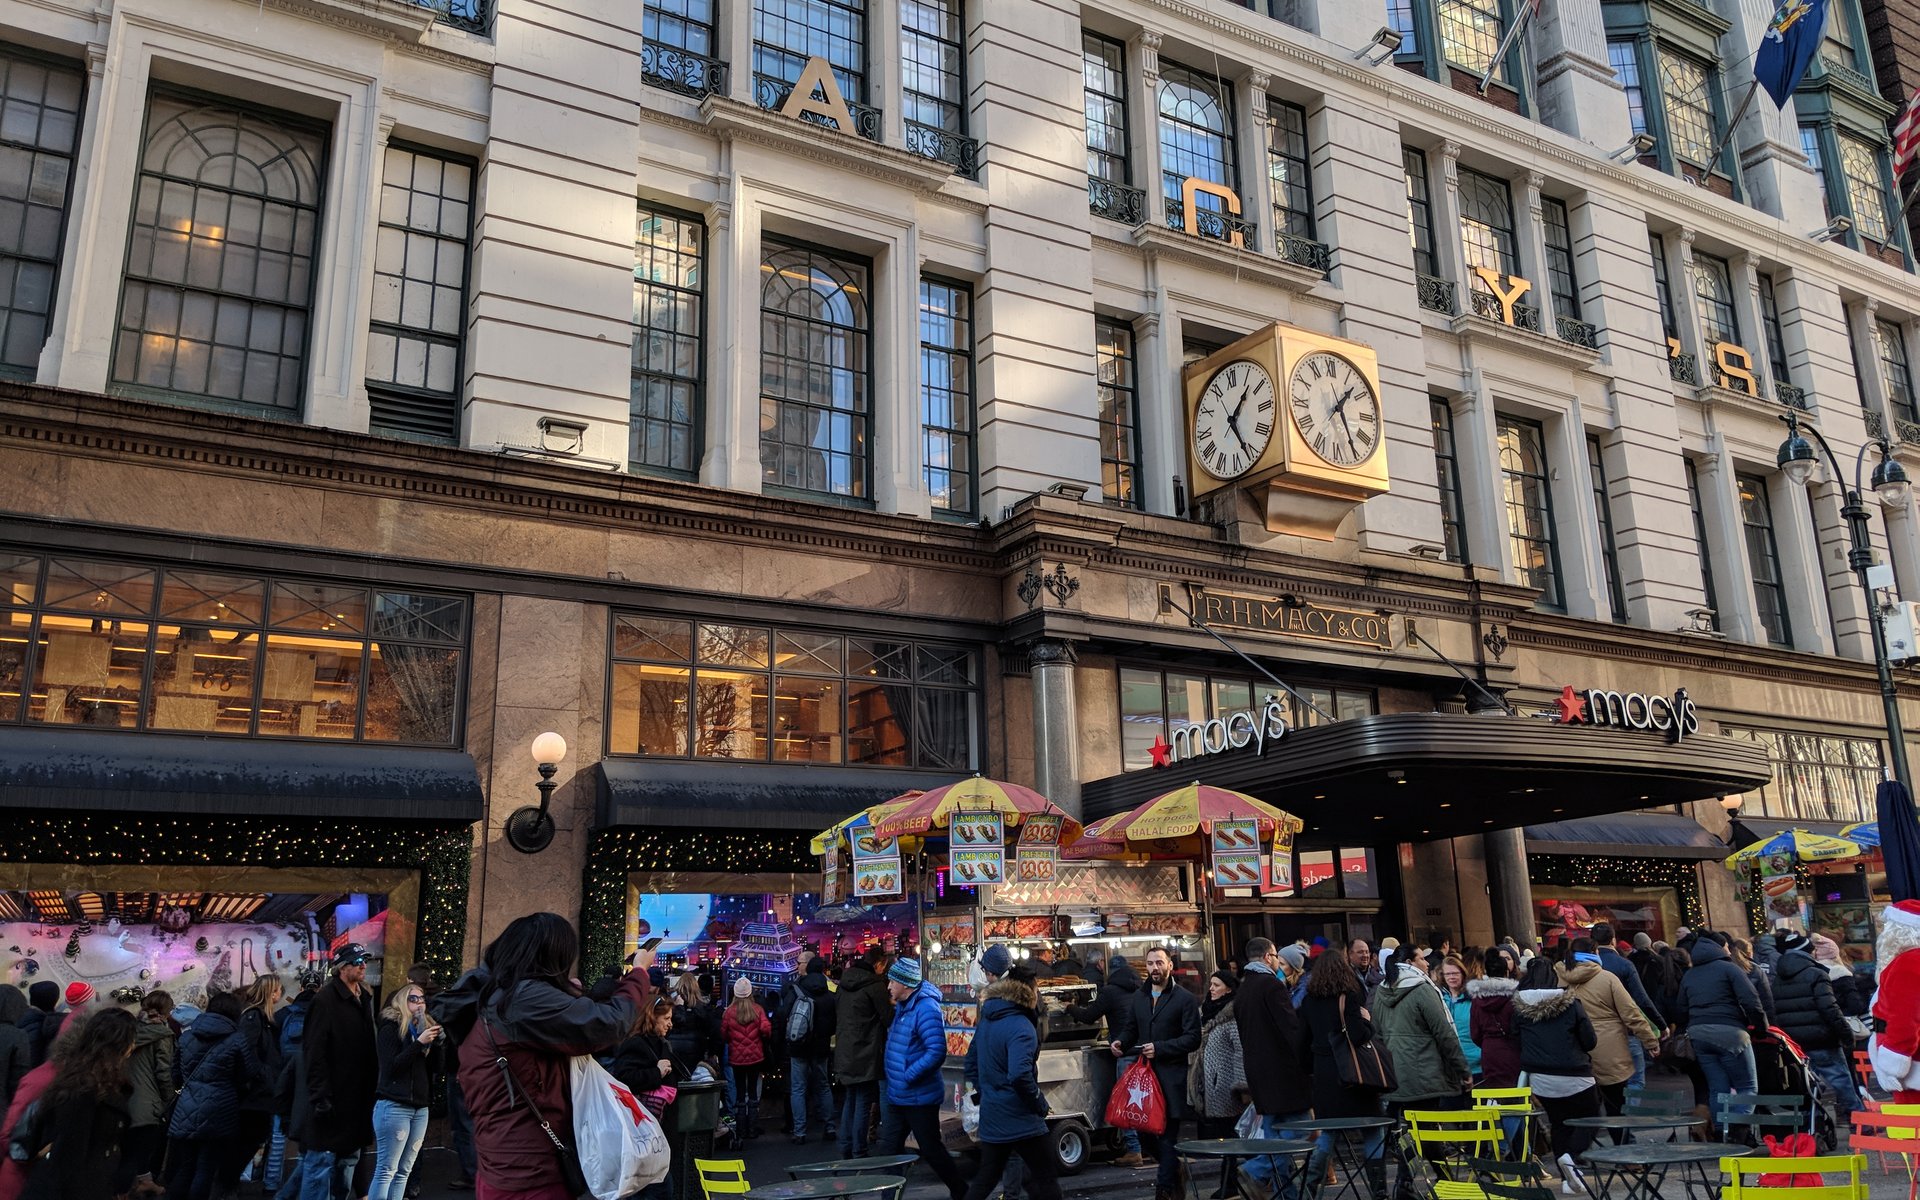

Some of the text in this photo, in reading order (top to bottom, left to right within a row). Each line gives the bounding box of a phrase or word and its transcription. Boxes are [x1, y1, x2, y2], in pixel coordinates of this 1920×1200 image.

[1586, 687, 1699, 743] macy's
[1171, 693, 1287, 763] macy's
[978, 815, 999, 823] GYRO
[1163, 814, 1193, 822] DOGS
[1132, 826, 1164, 836] HALAL
[1166, 825, 1194, 834] FOOD
[1074, 846, 1089, 854] Beef
[955, 852, 1000, 861] LAMB GYRO
